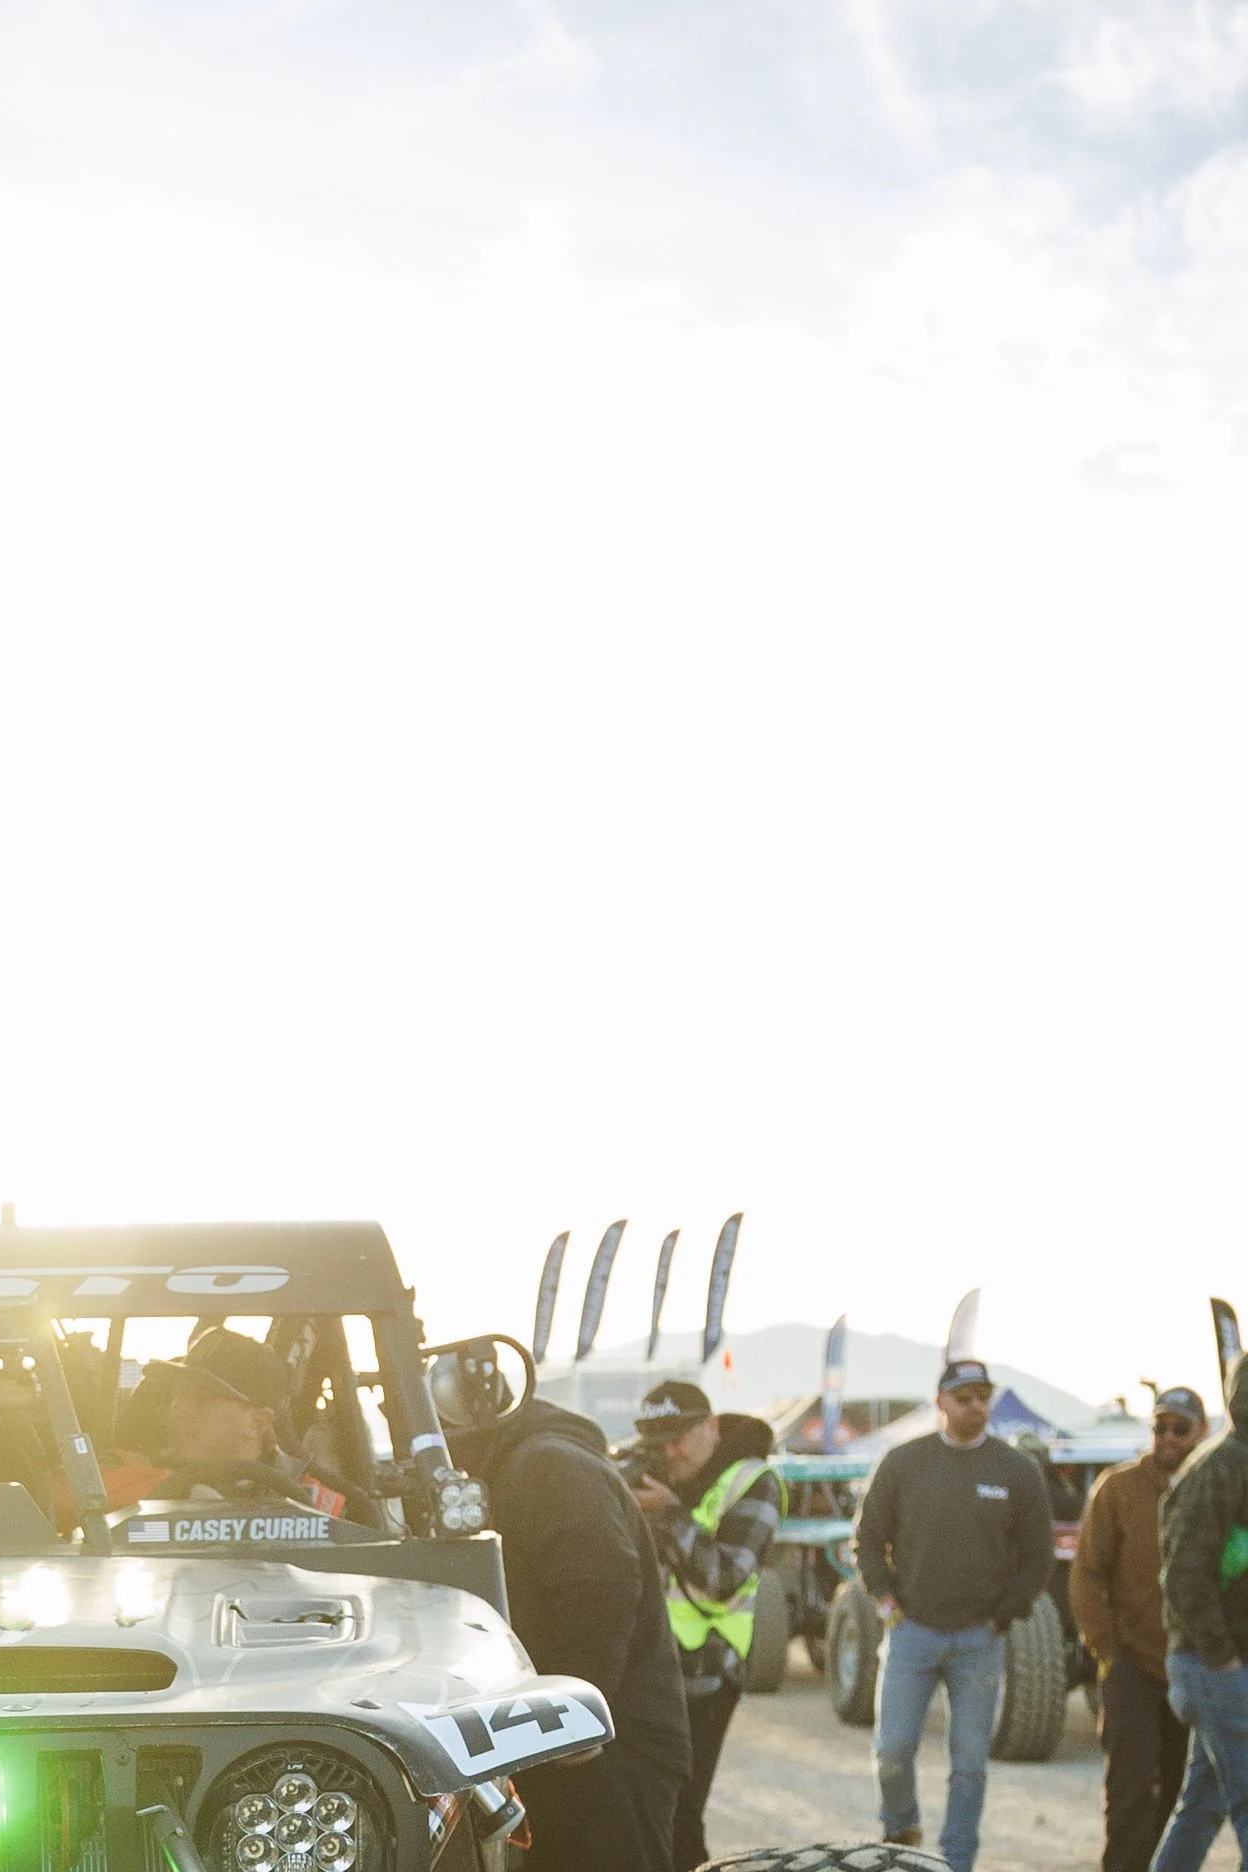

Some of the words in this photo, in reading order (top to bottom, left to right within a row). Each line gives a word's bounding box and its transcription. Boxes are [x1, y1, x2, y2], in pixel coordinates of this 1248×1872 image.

[174, 1519, 247, 1542] CASEY
[250, 1517, 330, 1541] CURRIE
[424, 1698, 570, 1758] 14
